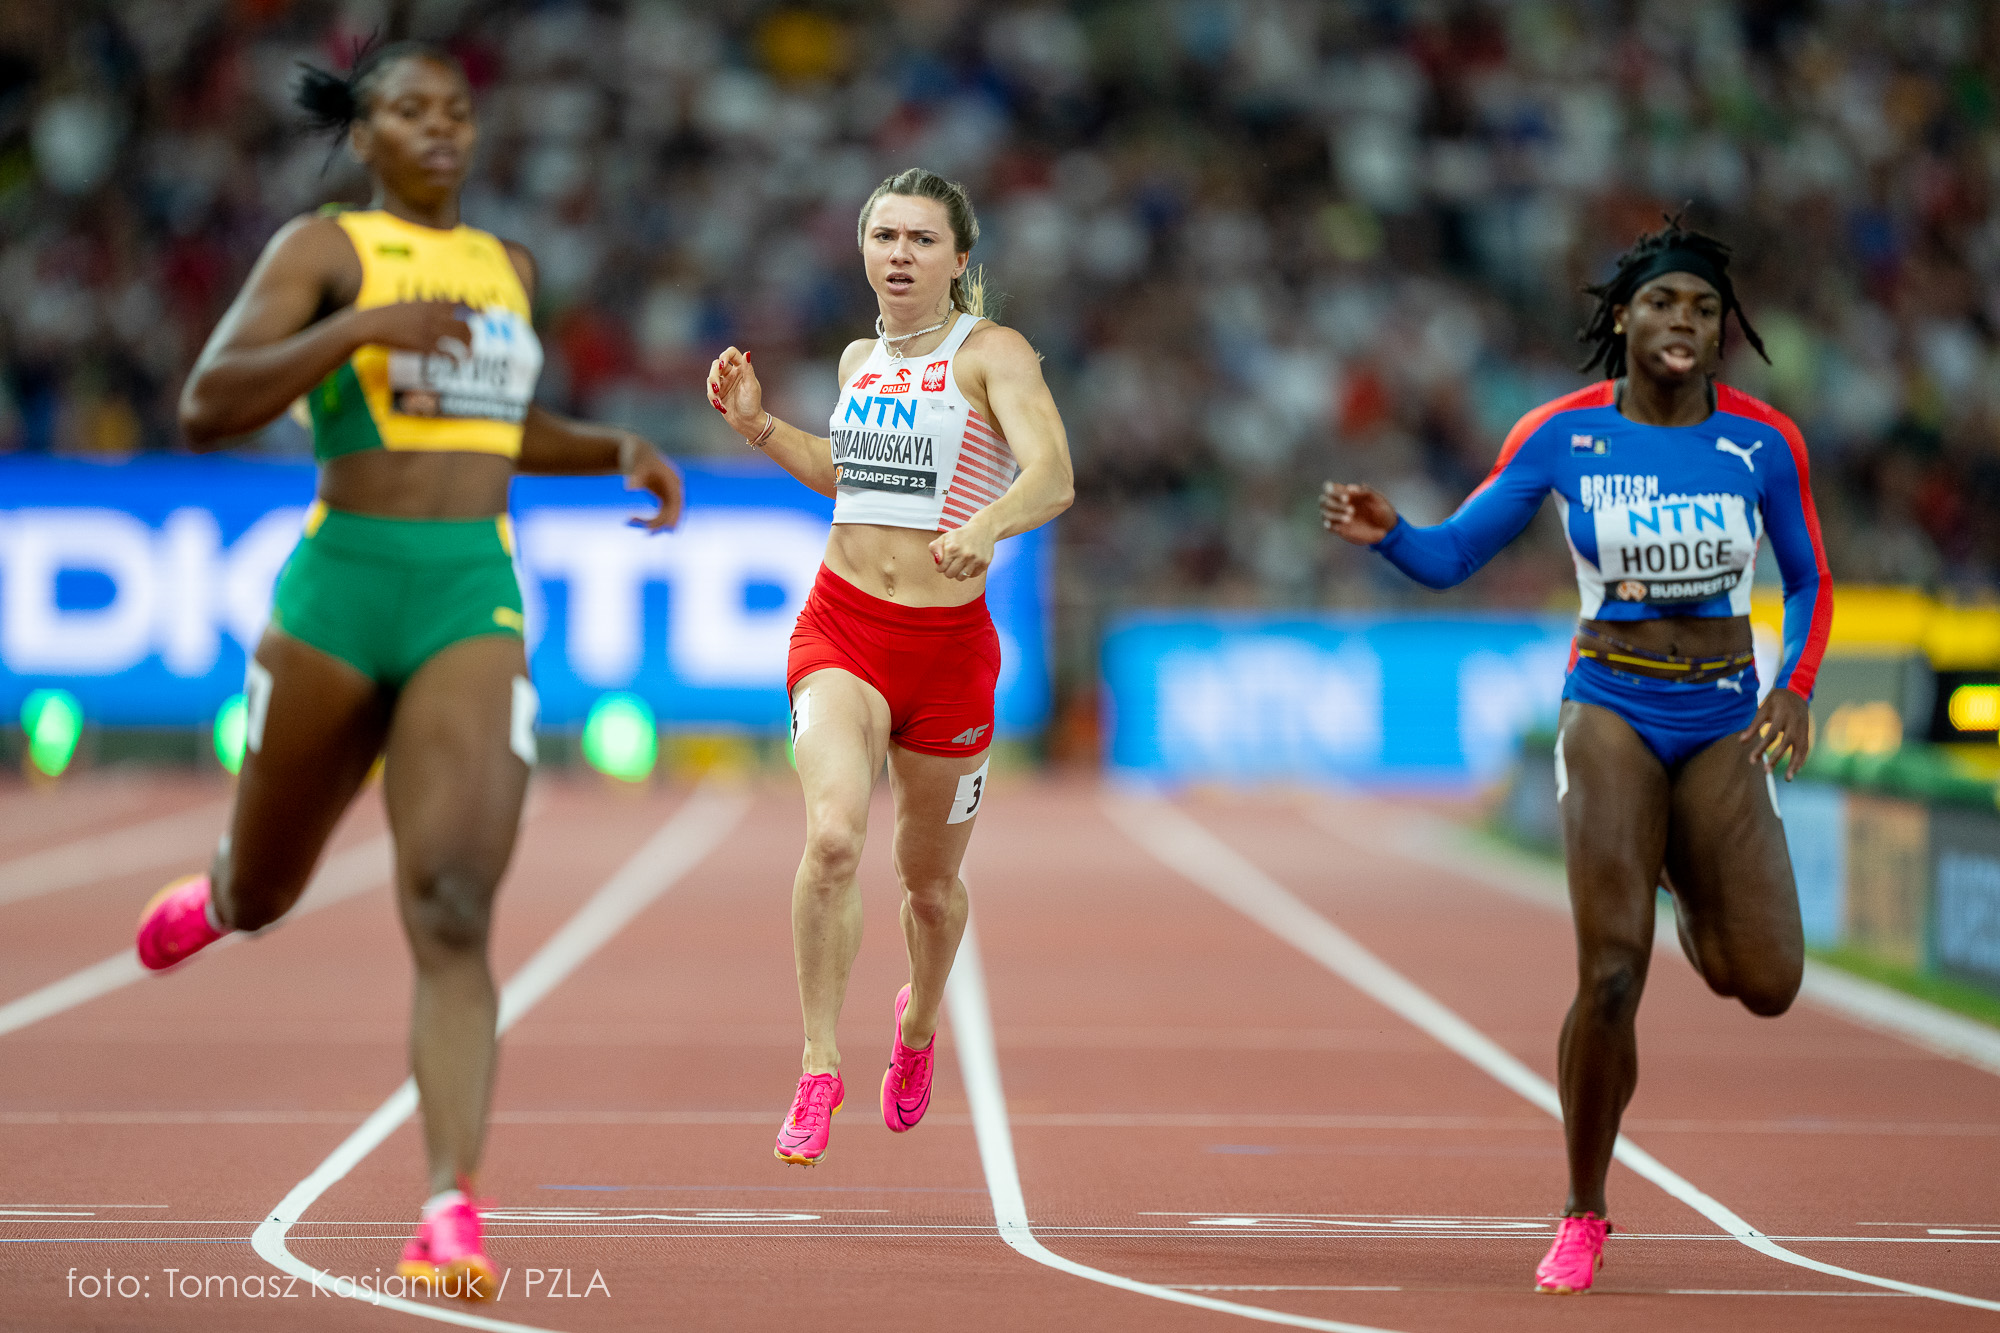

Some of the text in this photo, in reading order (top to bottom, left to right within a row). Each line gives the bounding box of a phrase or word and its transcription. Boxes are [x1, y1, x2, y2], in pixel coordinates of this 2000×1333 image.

[881, 384, 908, 393] ORLEN
[844, 395, 918, 430] NTN
[831, 429, 933, 467] TSIMANOUSKAYA
[843, 467, 927, 488] BUDAPEST 23
[1580, 474, 1658, 498] BRITISH
[1628, 502, 1725, 537] NTN
[1621, 540, 1732, 573] HODGE
[966, 776, 982, 814] 3
